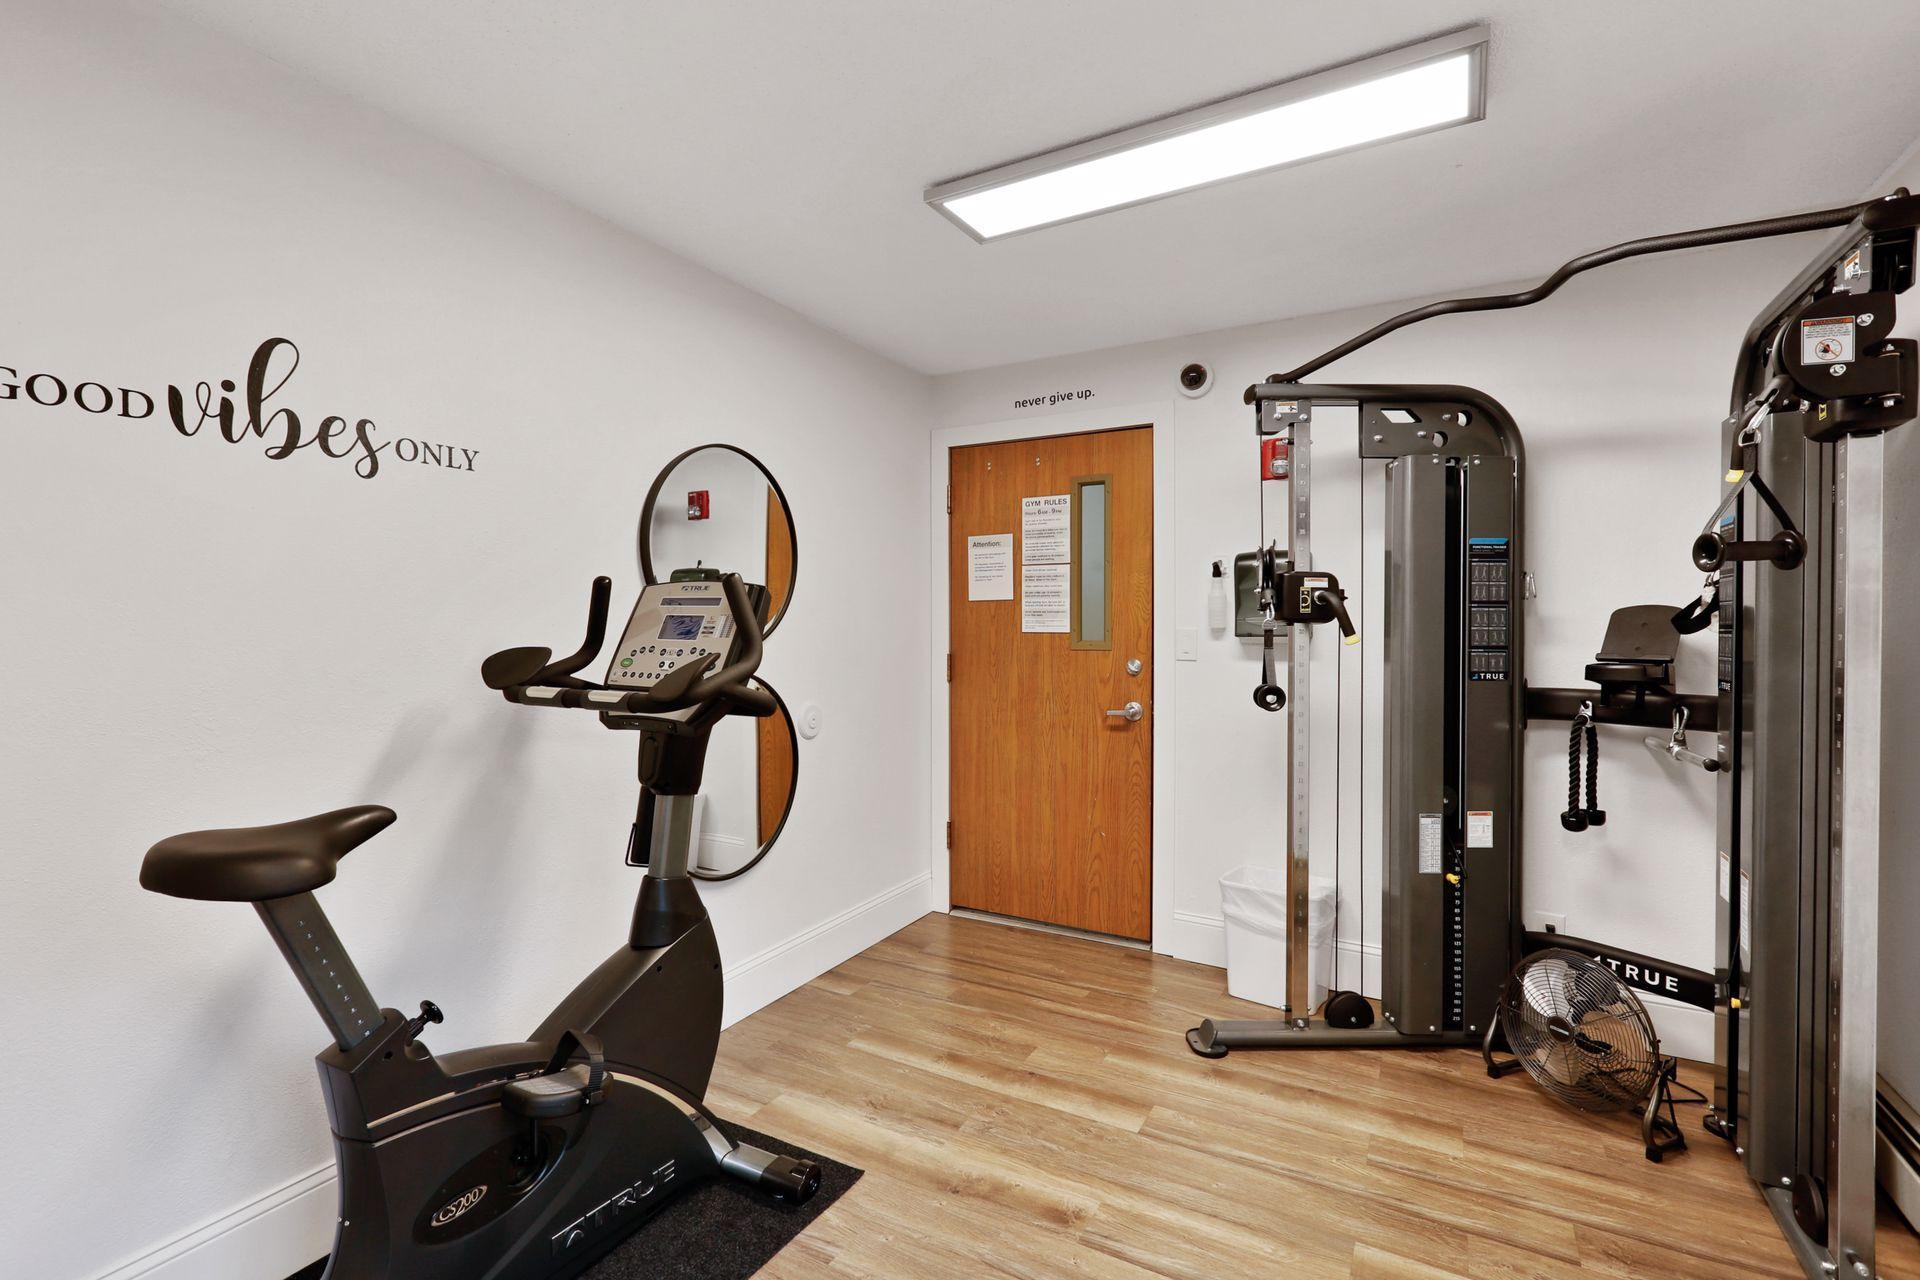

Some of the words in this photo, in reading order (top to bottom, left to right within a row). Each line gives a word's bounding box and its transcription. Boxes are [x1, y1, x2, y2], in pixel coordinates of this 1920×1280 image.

[0, 366, 154, 419] GOOD
[167, 337, 391, 479] vibes
[395, 437, 479, 472] ONLY
[1014, 396, 1046, 408] never
[1049, 391, 1073, 405] give
[1077, 389, 1095, 400] up.
[1044, 498, 1067, 506] RULES
[1607, 958, 1679, 993] TRUE
[437, 1187, 480, 1222] CS200
[586, 1159, 675, 1229] TRUE
